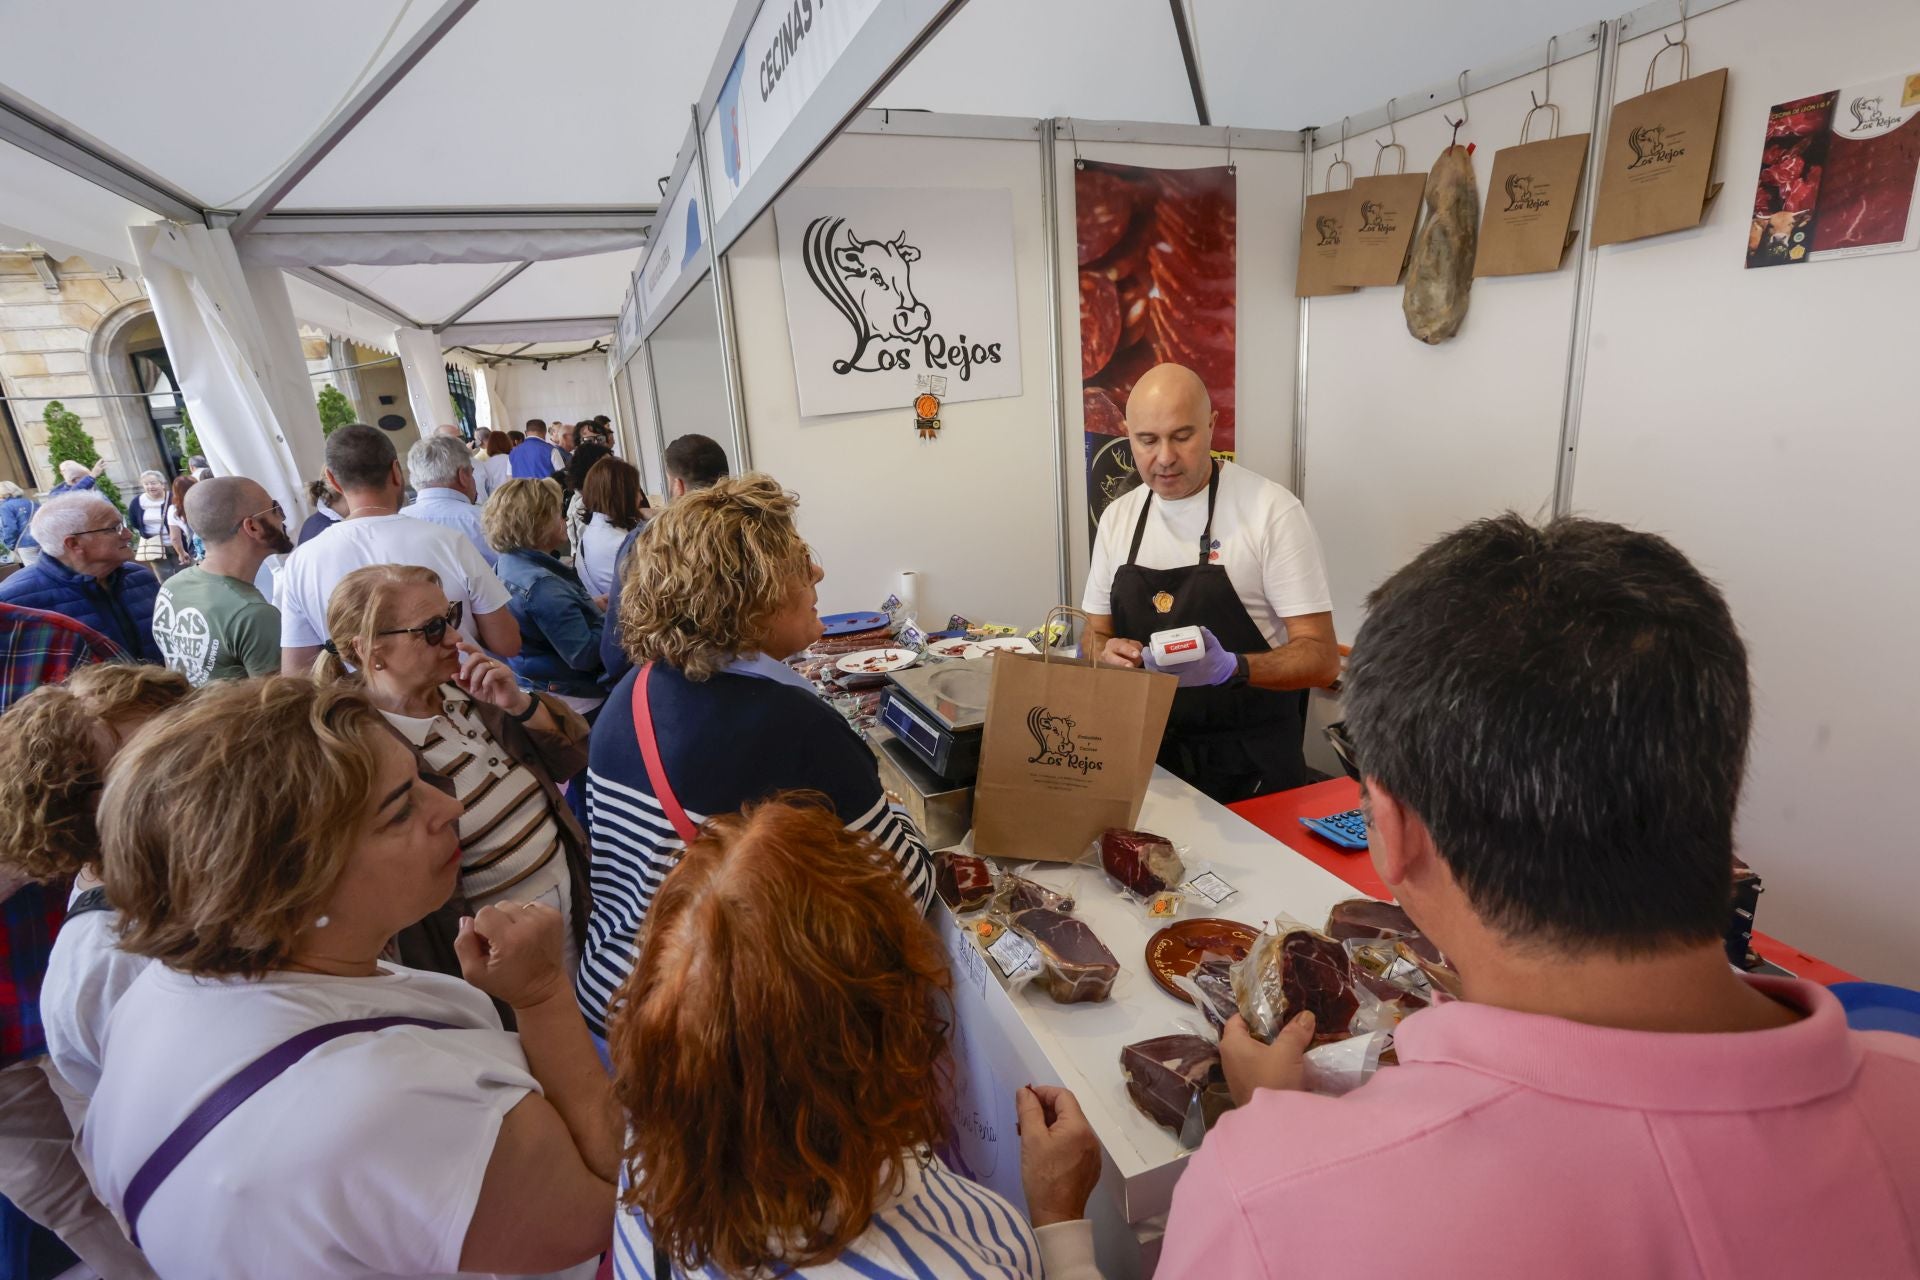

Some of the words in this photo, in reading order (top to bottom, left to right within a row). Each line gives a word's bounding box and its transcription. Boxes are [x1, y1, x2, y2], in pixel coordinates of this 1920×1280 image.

[761, 0, 812, 102] CECINAS
[1656, 148, 1685, 164] Rejos
[833, 336, 911, 375] Los
[923, 333, 1002, 381] Rejos
[153, 600, 208, 636] ANS
[1028, 750, 1063, 766] Los
[1068, 754, 1103, 775] Rejos
